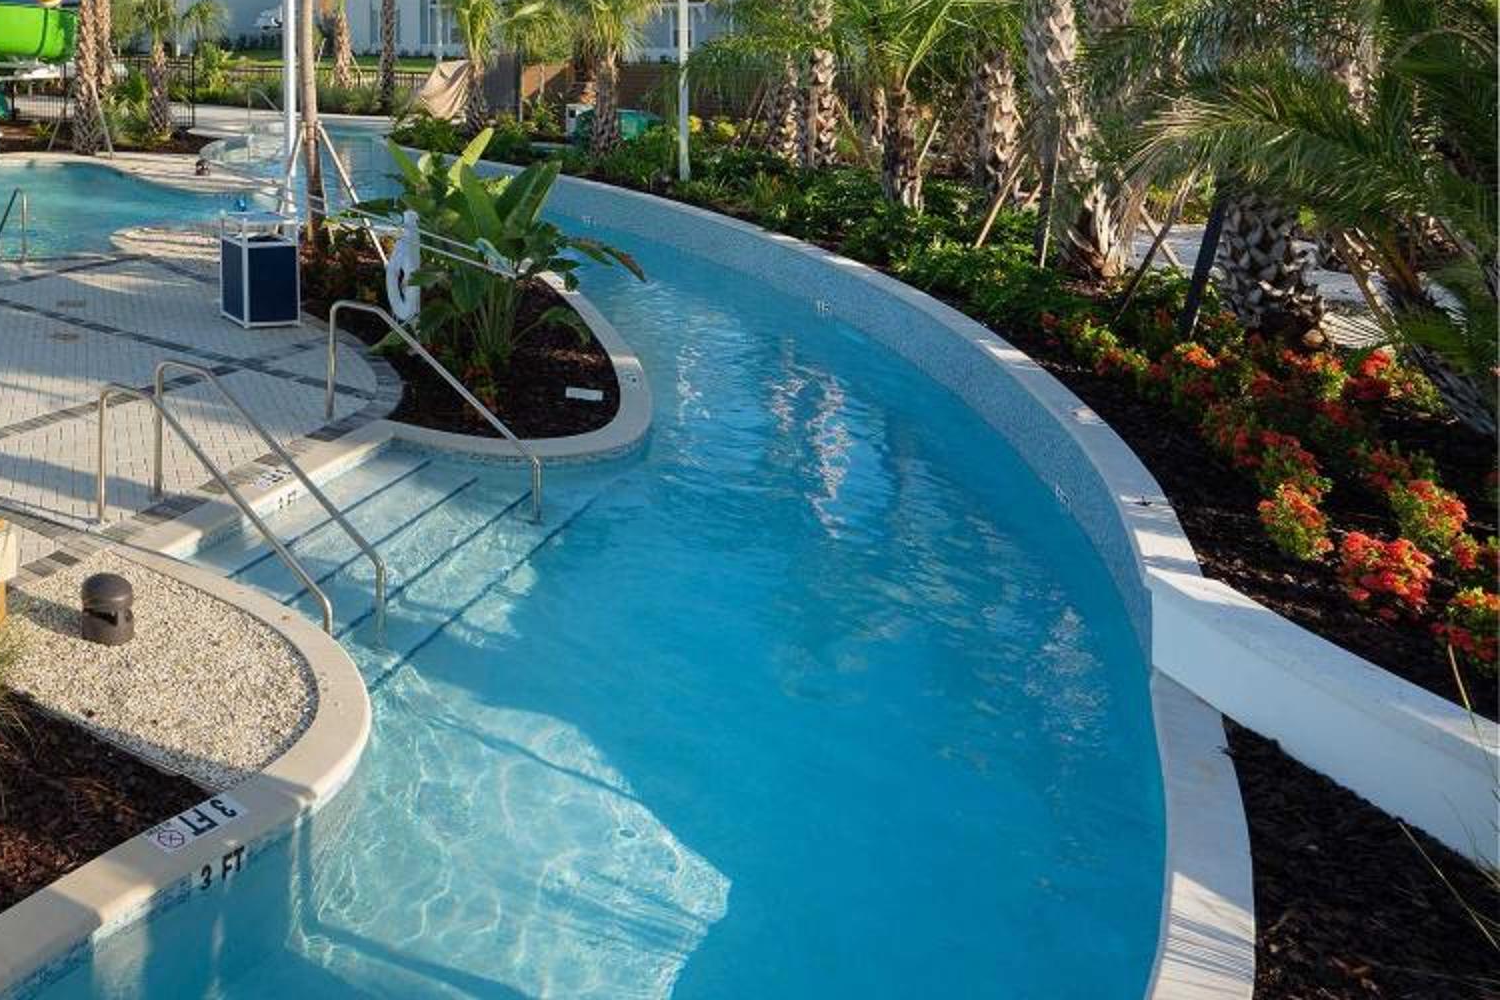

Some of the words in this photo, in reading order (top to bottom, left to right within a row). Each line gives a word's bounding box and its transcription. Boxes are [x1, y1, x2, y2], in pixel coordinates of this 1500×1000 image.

[178, 808, 219, 836] FT
[210, 799, 237, 818] 3
[201, 864, 212, 890] 3
[221, 845, 245, 880] FT
